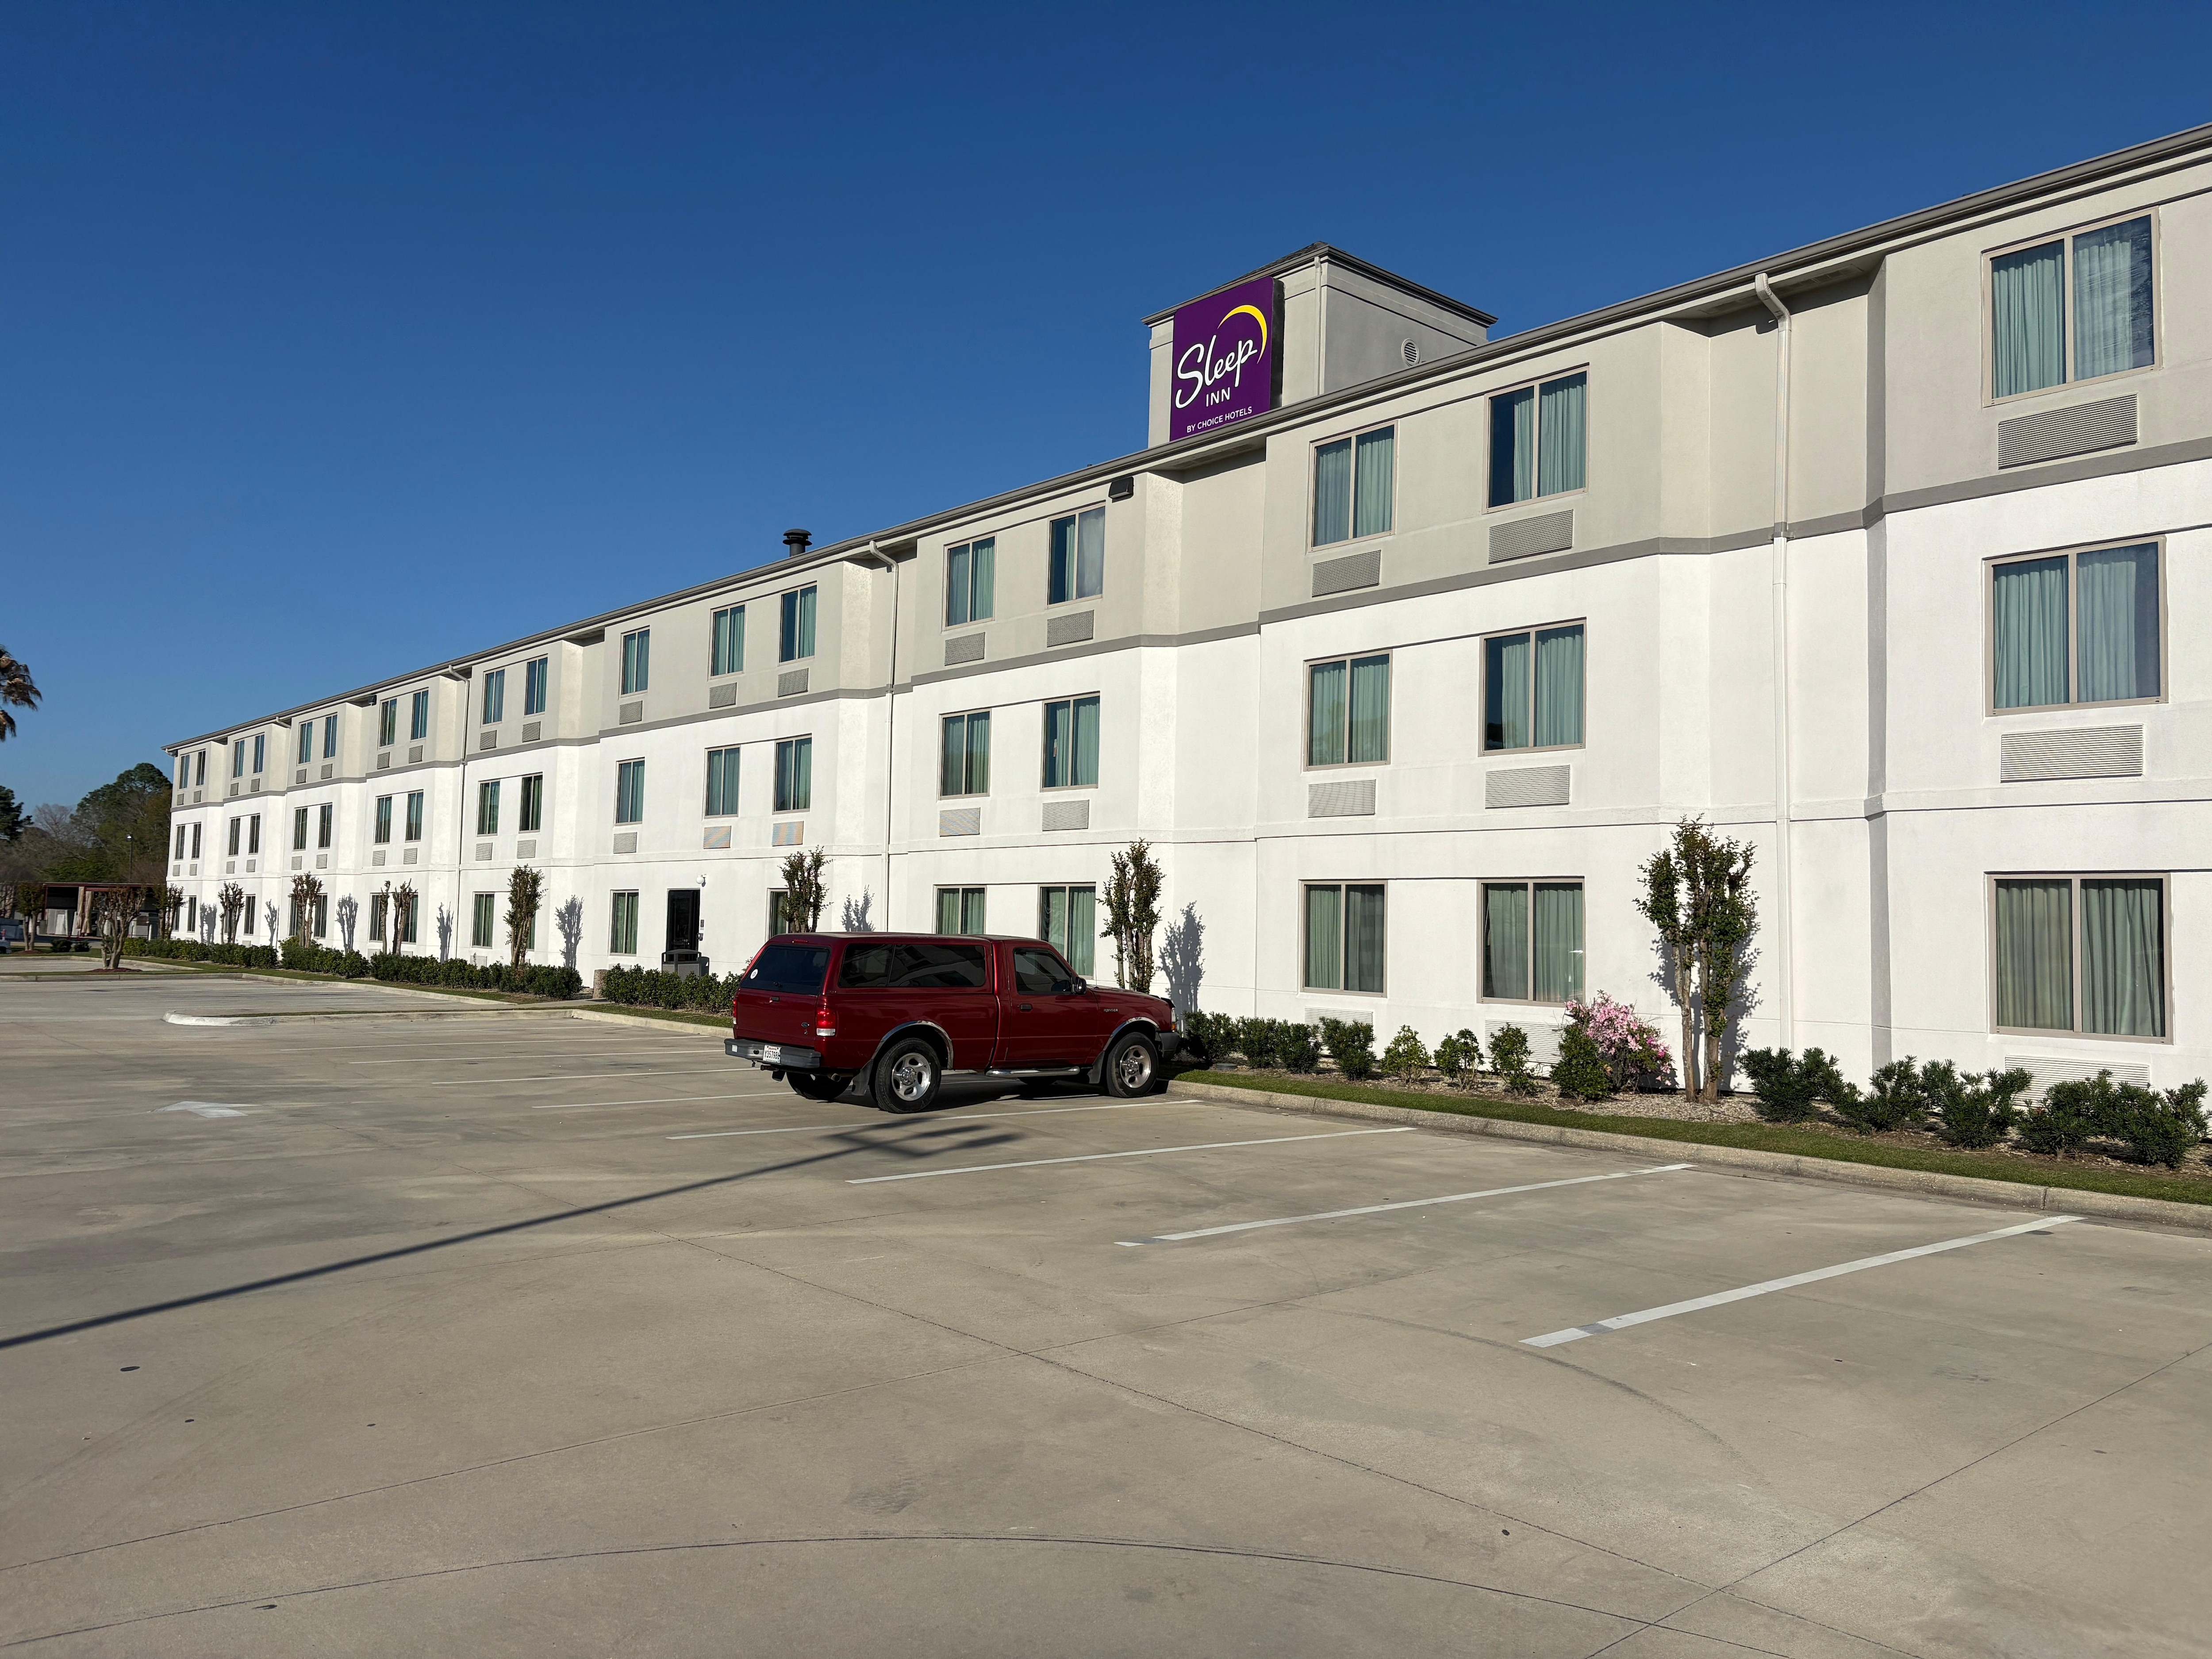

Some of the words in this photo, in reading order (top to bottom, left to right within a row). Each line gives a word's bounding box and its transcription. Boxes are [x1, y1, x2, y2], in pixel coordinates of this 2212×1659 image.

[1175, 334, 1258, 408] Sleep
[1206, 387, 1230, 407] INN
[1187, 423, 1196, 433] BY
[1197, 415, 1223, 429] CHOICE
[1225, 406, 1252, 421] HOTELS
